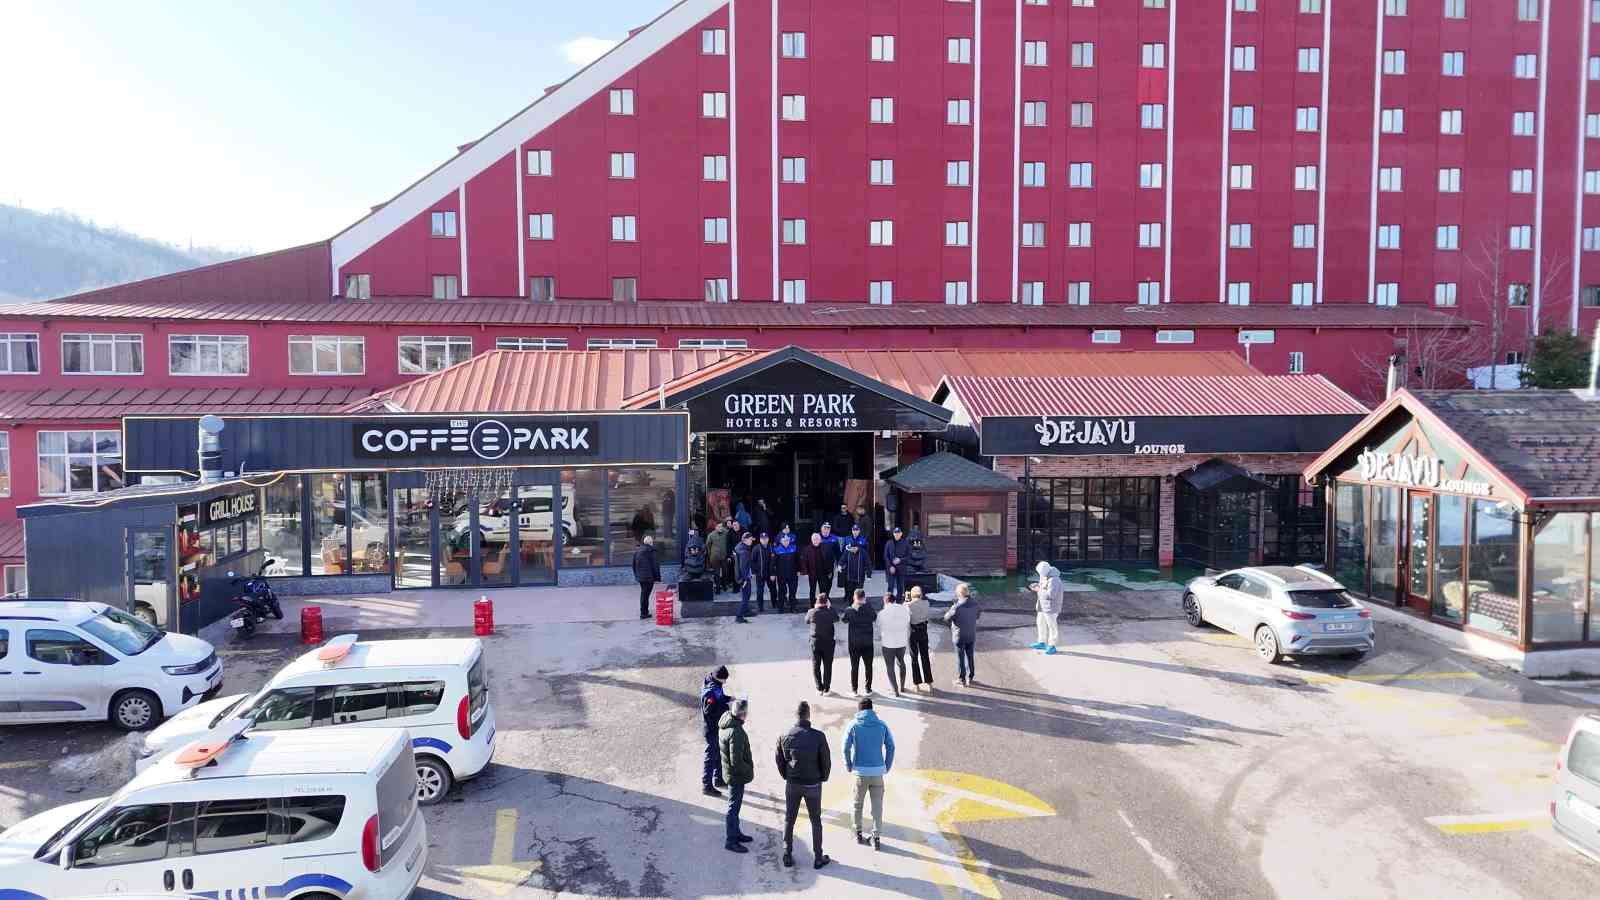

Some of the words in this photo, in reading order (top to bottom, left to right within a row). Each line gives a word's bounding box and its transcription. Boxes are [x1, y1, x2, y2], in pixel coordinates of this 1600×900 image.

[724, 393, 794, 415] GREEN
[803, 393, 855, 415] PARK
[726, 418, 778, 428] HOTELS
[785, 418, 793, 428] &
[799, 418, 858, 428] RESORTS
[1034, 416, 1136, 446] DEJAVU
[513, 427, 590, 452] PARK
[1134, 444, 1186, 454] LOUNGE
[1357, 446, 1441, 487] DEJAVU
[1439, 480, 1492, 495] LOUNGE
[209, 499, 231, 521] GRILL
[231, 494, 255, 514] HOUSE
